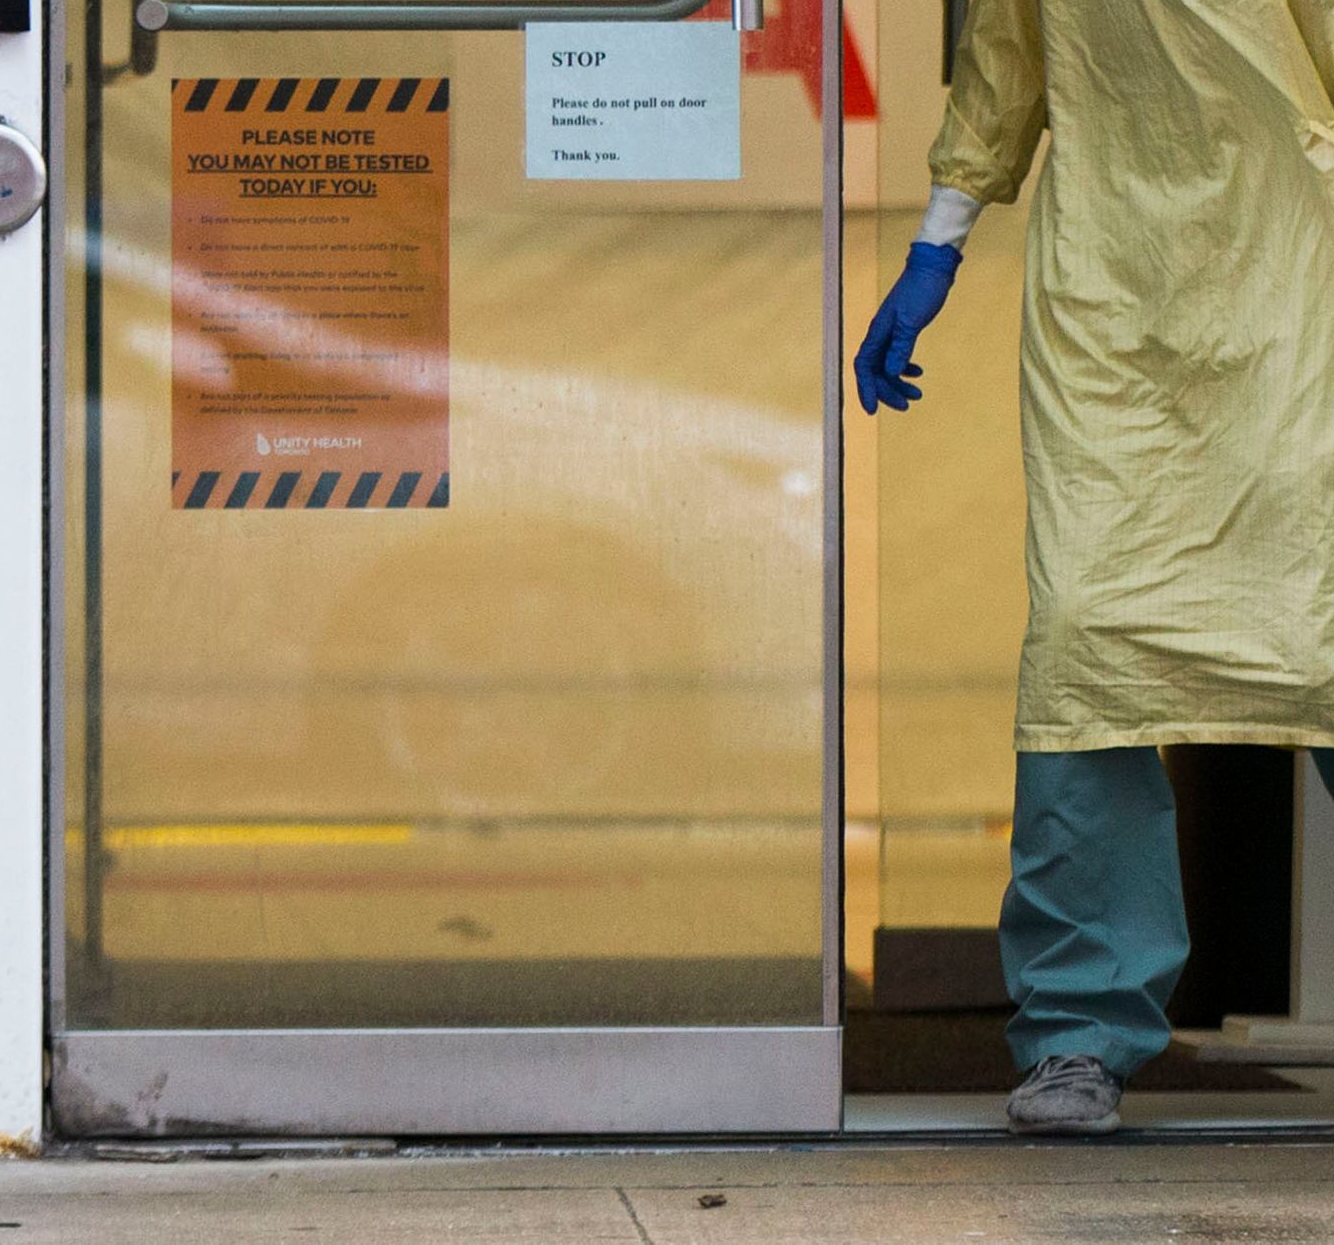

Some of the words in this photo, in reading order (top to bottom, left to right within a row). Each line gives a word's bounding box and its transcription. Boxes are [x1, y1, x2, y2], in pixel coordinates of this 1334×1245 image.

[552, 52, 606, 67] STOP
[552, 98, 588, 108] Please
[592, 98, 607, 108] do
[611, 99, 630, 108] not
[634, 97, 657, 111] pull
[660, 100, 675, 108] on
[679, 97, 707, 107] door
[242, 130, 317, 145] PLEASE
[322, 130, 375, 145] NOTE
[188, 155, 228, 170] YOU
[234, 155, 276, 170] MAY
[281, 154, 321, 170] NOT
[325, 155, 350, 170] BE
[354, 155, 429, 170] TESTED
[553, 150, 591, 160] Thank
[595, 153, 621, 164] you.
[240, 179, 305, 194] TODAY
[310, 179, 326, 194] IF
[331, 179, 376, 194] YOU:
[313, 437, 362, 449] HEALTH
